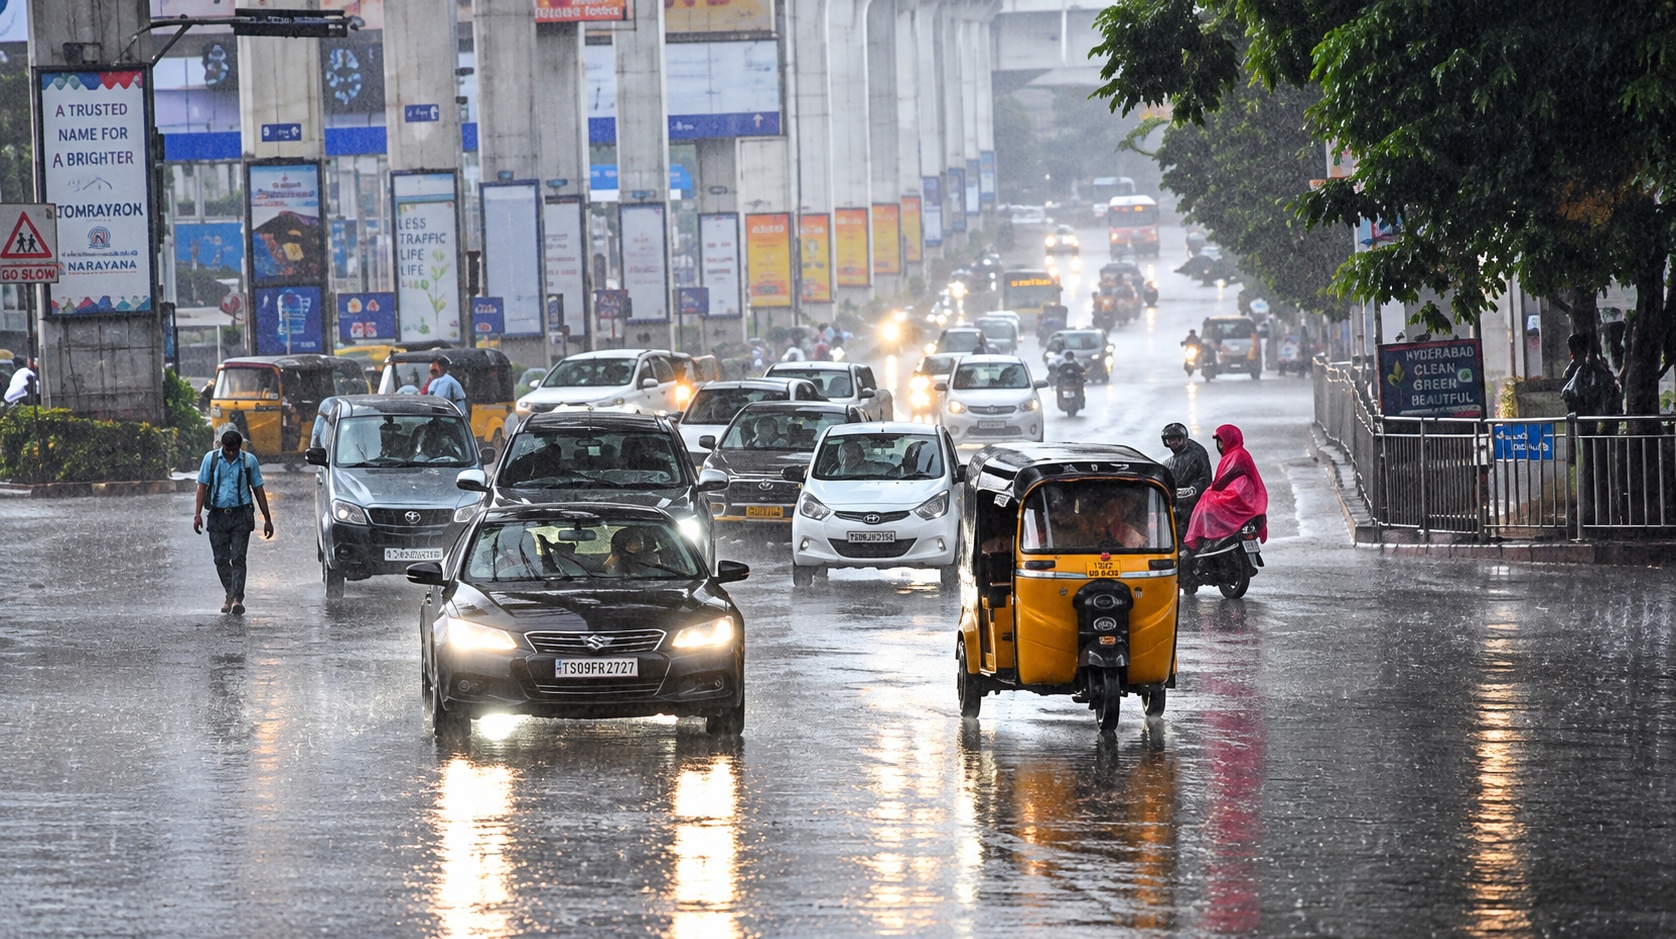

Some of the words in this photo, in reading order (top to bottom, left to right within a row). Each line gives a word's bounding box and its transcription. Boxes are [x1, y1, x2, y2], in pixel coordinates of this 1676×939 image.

[55, 104, 66, 118] A
[68, 103, 128, 117] TRUSTED
[58, 127, 97, 142] NAME
[101, 126, 128, 141] FOR
[52, 152, 64, 168] A
[67, 151, 134, 167] BRIGHTER
[399, 217, 427, 230] LESS
[399, 232, 447, 245] TRAFFIC
[400, 248, 425, 261] LIFE
[68, 260, 137, 271] NARAYANA
[400, 264, 425, 276] LIFE
[2, 269, 18, 280] GO
[21, 268, 56, 280] SLOW
[1406, 346, 1474, 361] HYDERABAD
[1414, 362, 1455, 376] CLEAN
[1411, 391, 1474, 407] BEAUTFUL
[562, 661, 635, 675] TS09FR2727
